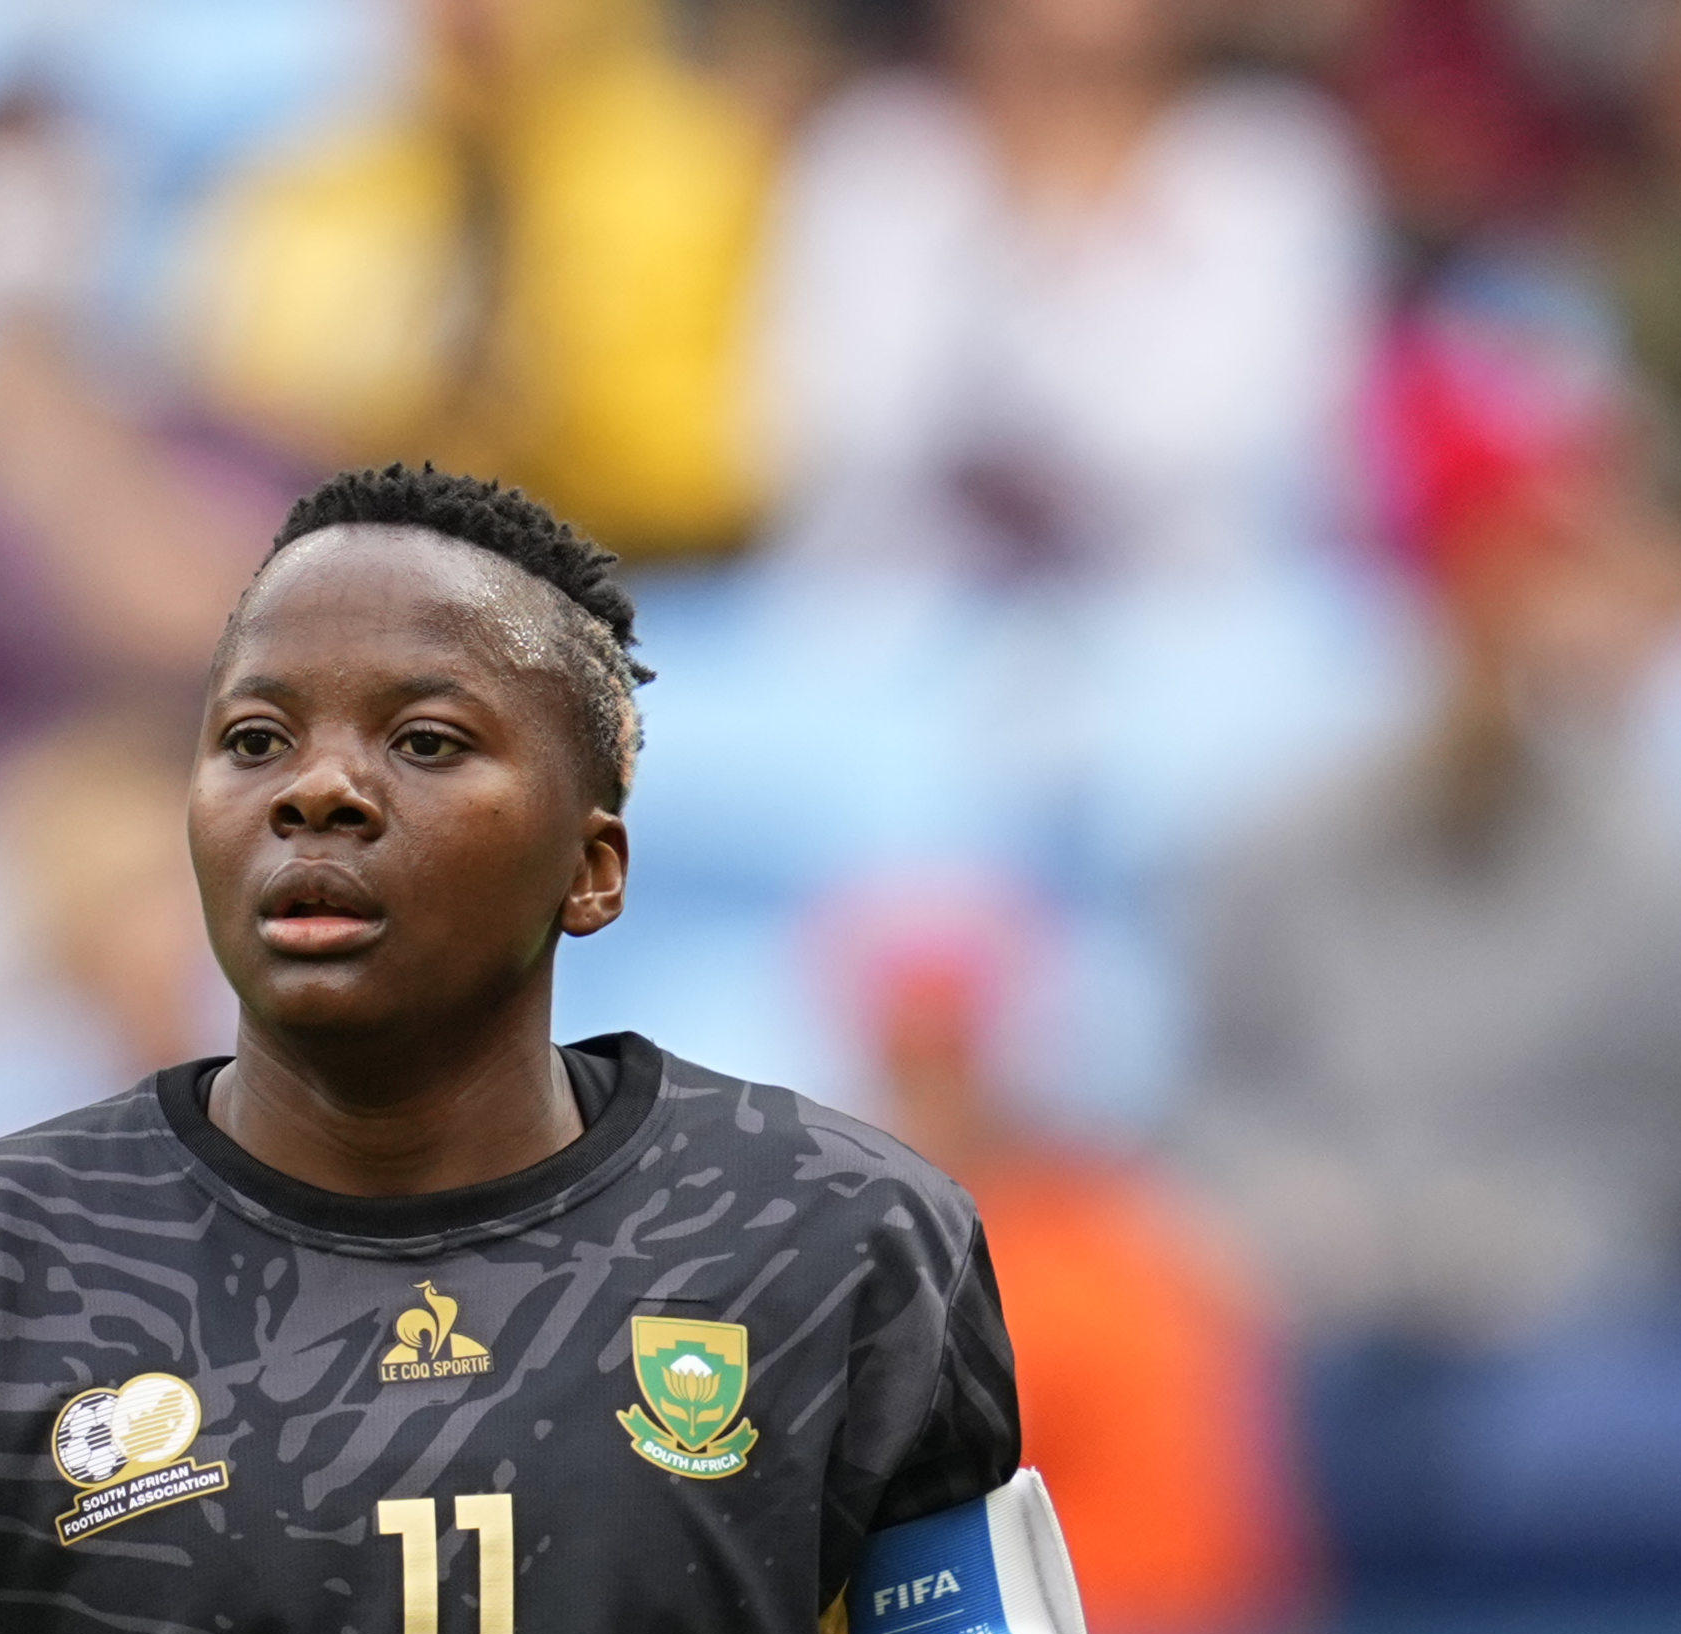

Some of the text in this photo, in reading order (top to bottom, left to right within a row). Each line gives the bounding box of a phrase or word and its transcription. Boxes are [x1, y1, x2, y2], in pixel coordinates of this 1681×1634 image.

[381, 1355, 491, 1382] LE COQ SPORTIF
[643, 1440, 740, 1472] SOUTH AFRICA
[64, 1471, 220, 1537] FOOTBALL ASSOCIATION
[82, 1466, 190, 1512] SOUTH AFRICAN
[874, 1569, 961, 1616] FIFA
